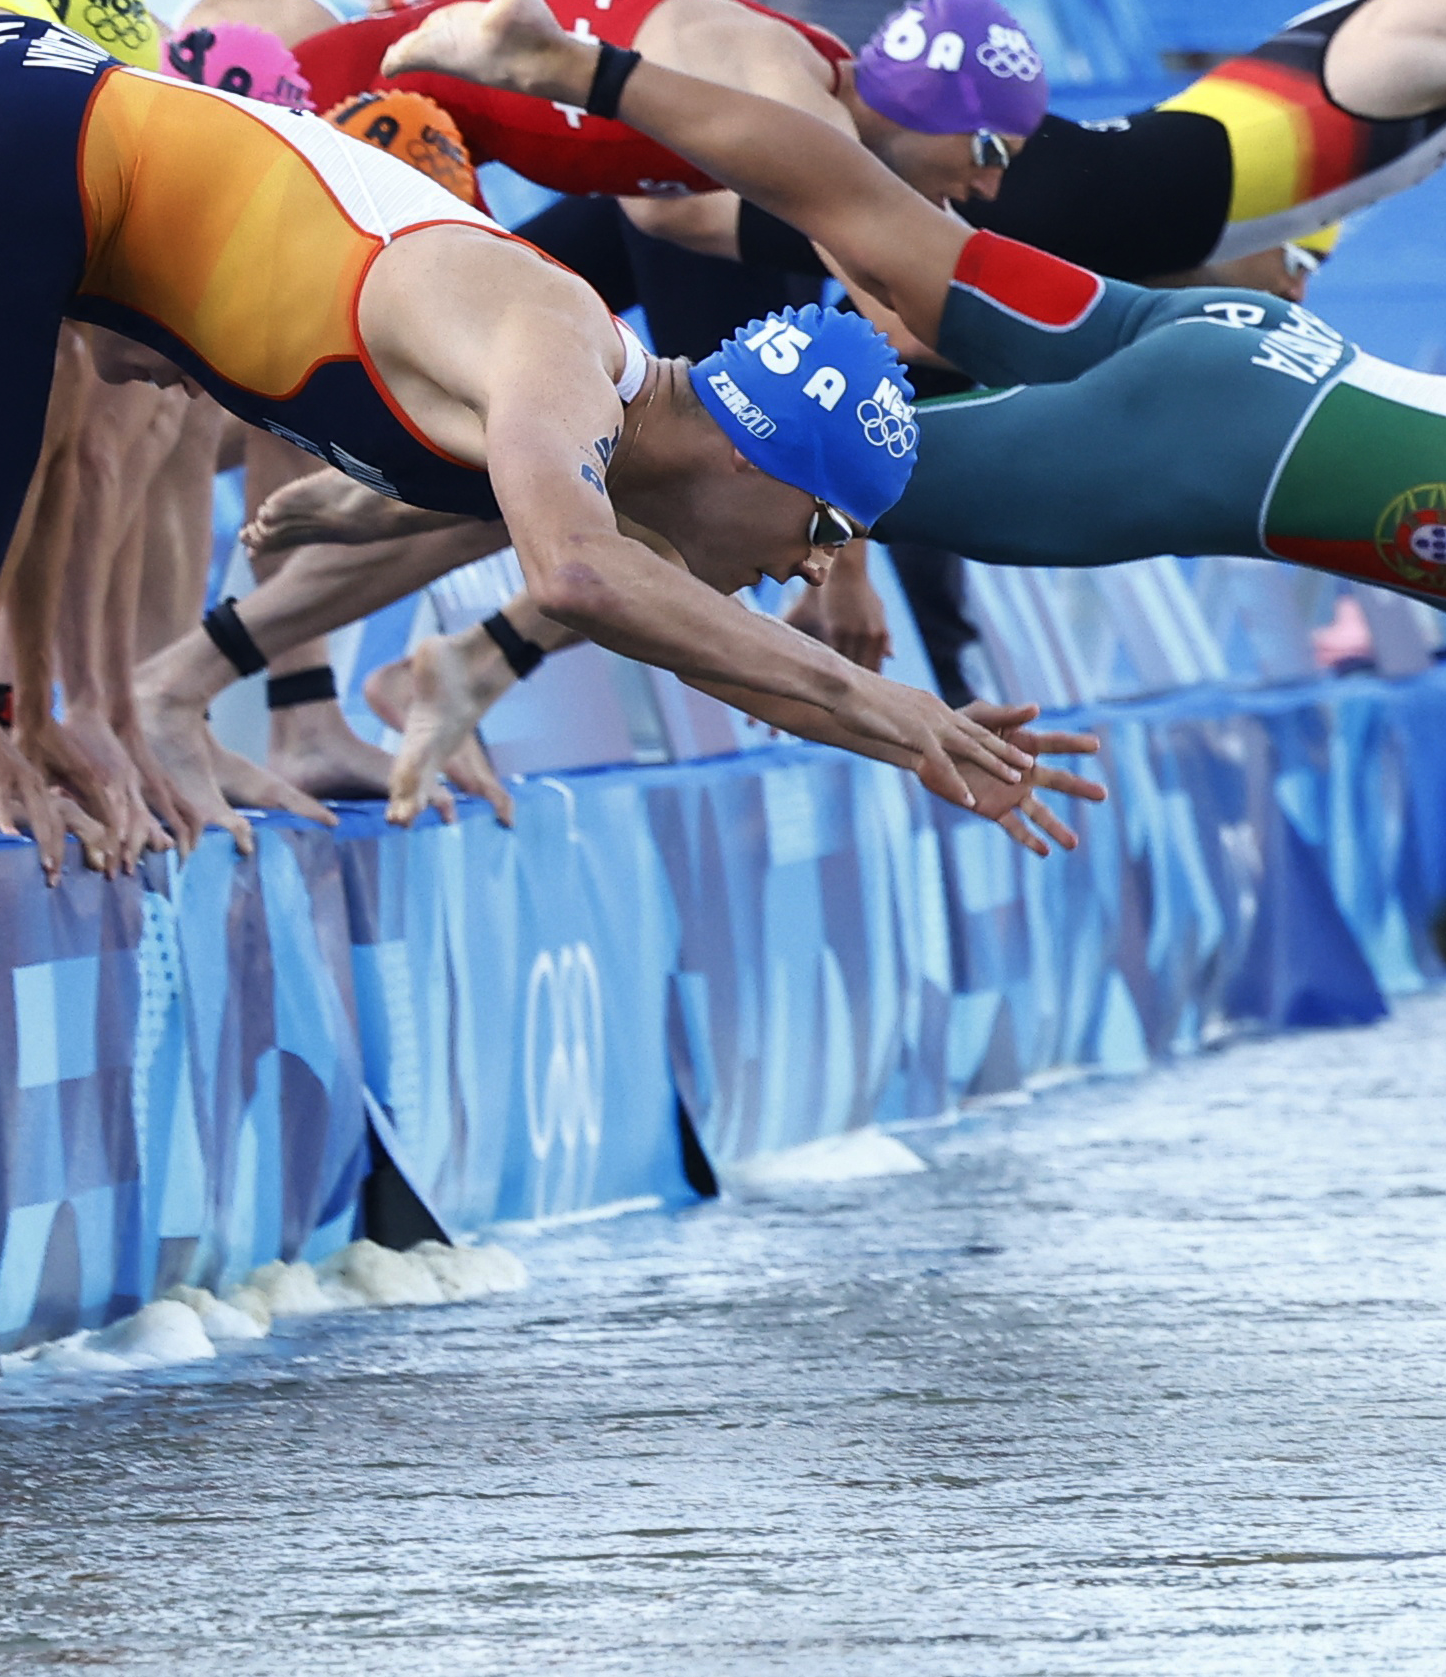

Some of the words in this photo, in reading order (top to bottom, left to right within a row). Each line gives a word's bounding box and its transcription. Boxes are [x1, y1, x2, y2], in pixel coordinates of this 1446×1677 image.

[926, 30, 965, 72] A
[364, 115, 399, 148] A
[744, 318, 814, 375] 15
[802, 366, 847, 412] A
